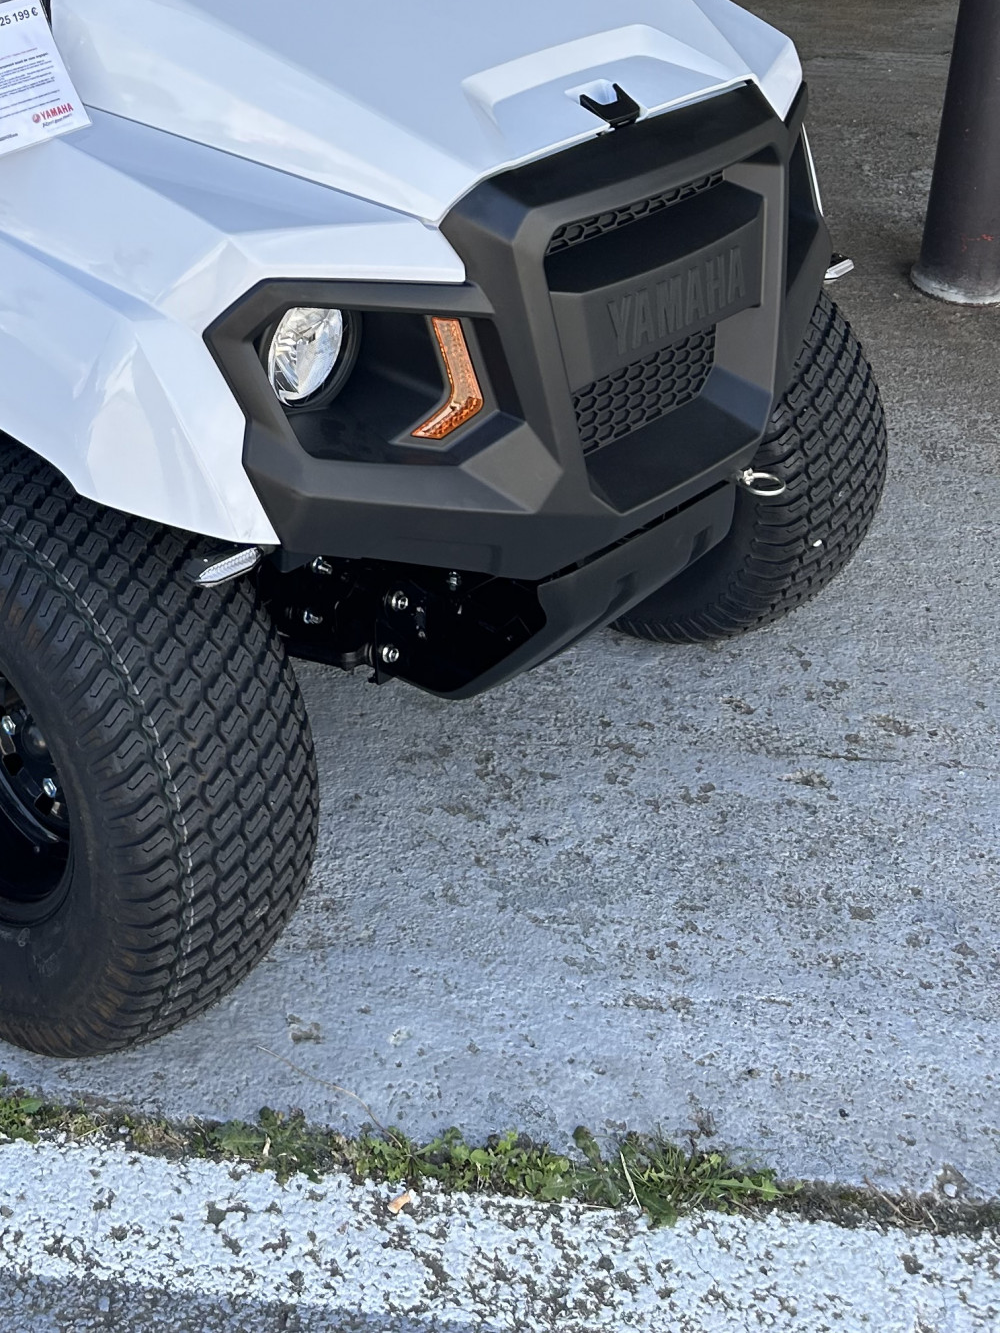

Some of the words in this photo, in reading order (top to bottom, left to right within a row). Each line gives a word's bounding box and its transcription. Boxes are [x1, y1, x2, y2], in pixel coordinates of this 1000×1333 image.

[0, 15, 11, 27] 25
[14, 8, 30, 22] 199
[31, 6, 39, 17] €
[40, 102, 74, 120] YAMAHA
[606, 245, 746, 356] YAMAHA
